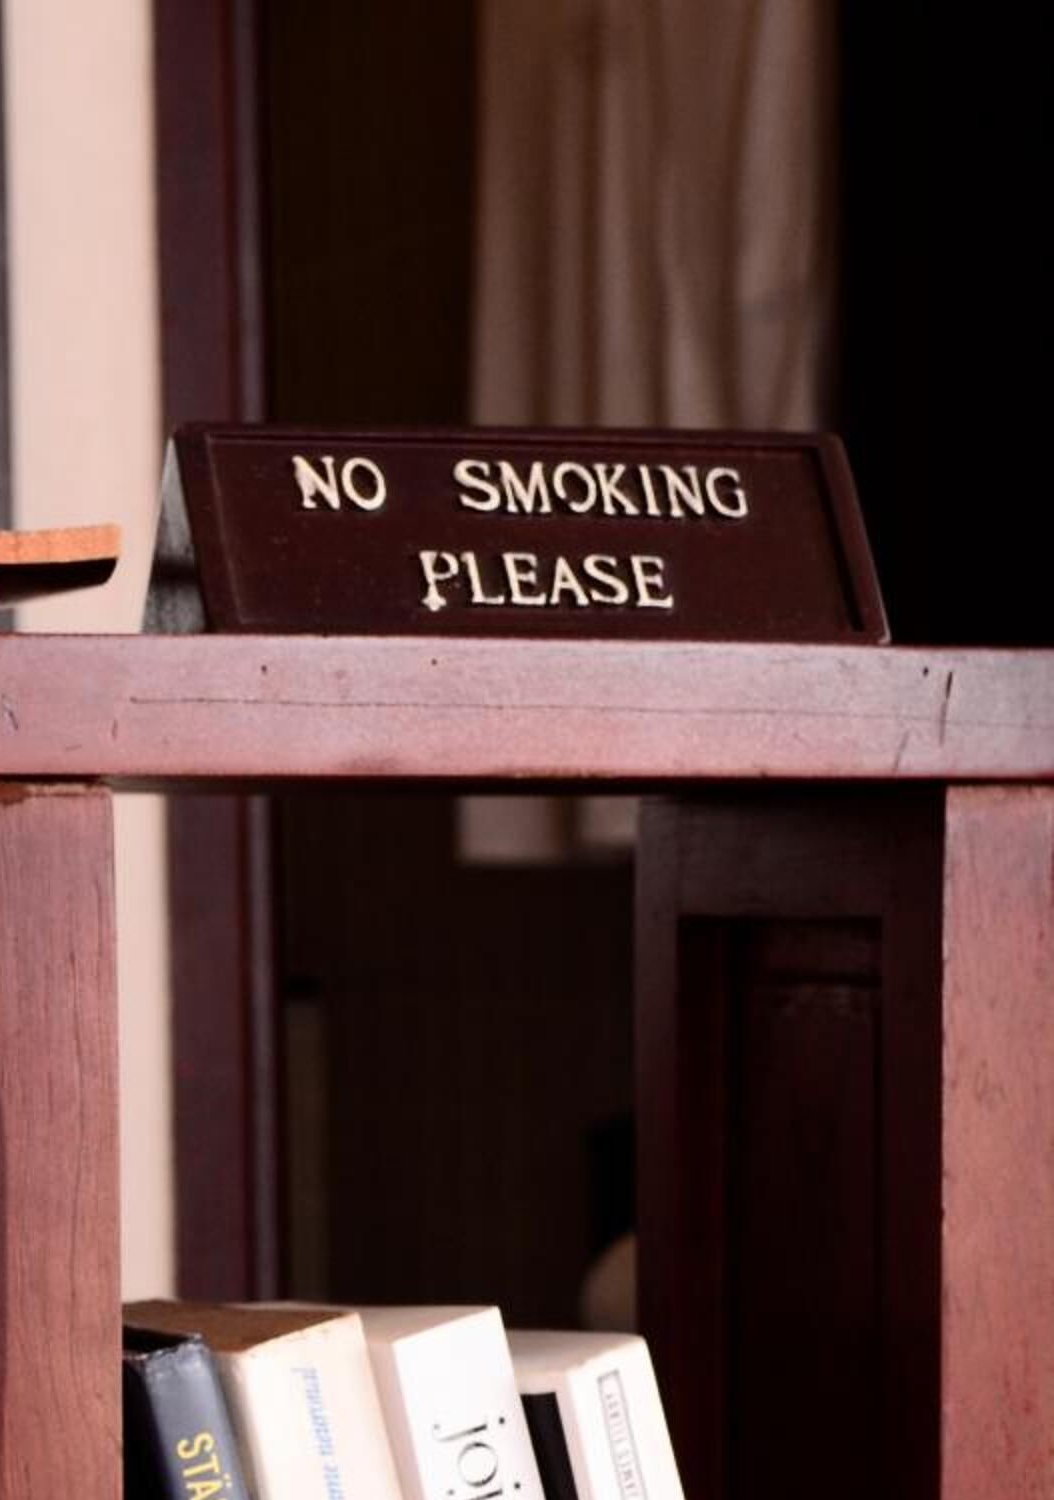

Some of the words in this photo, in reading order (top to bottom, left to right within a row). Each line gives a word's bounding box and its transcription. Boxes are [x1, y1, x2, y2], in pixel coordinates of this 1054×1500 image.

[292, 455, 387, 512] NO
[453, 459, 748, 518] SMOKING
[419, 550, 674, 611] PLEASE
